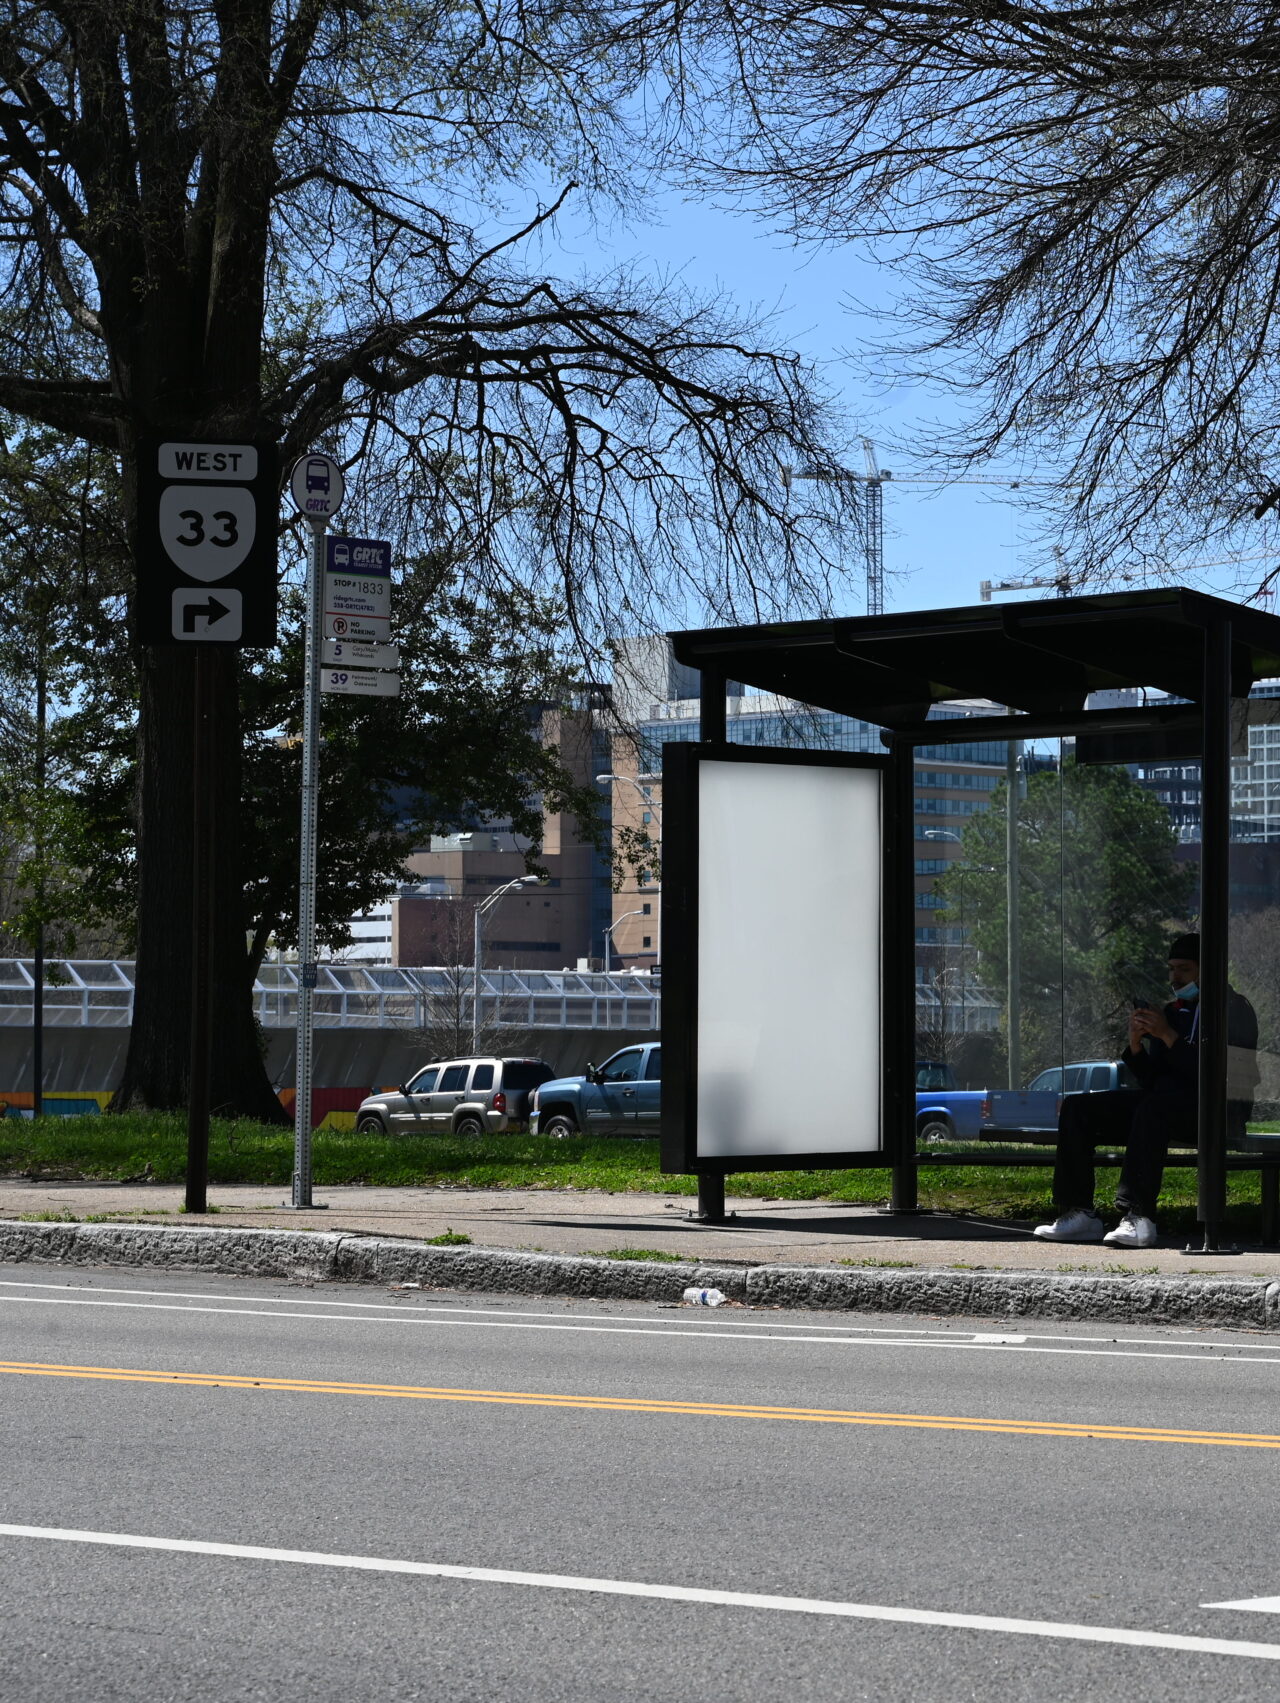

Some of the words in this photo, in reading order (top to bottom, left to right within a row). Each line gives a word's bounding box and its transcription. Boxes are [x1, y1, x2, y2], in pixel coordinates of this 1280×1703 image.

[175, 451, 243, 472] WEST
[305, 498, 331, 512] GRTC
[175, 510, 239, 548] 33
[353, 547, 384, 564] GRTC
[357, 581, 384, 595] 1833
[334, 644, 342, 656] 5
[330, 672, 348, 685] 39
